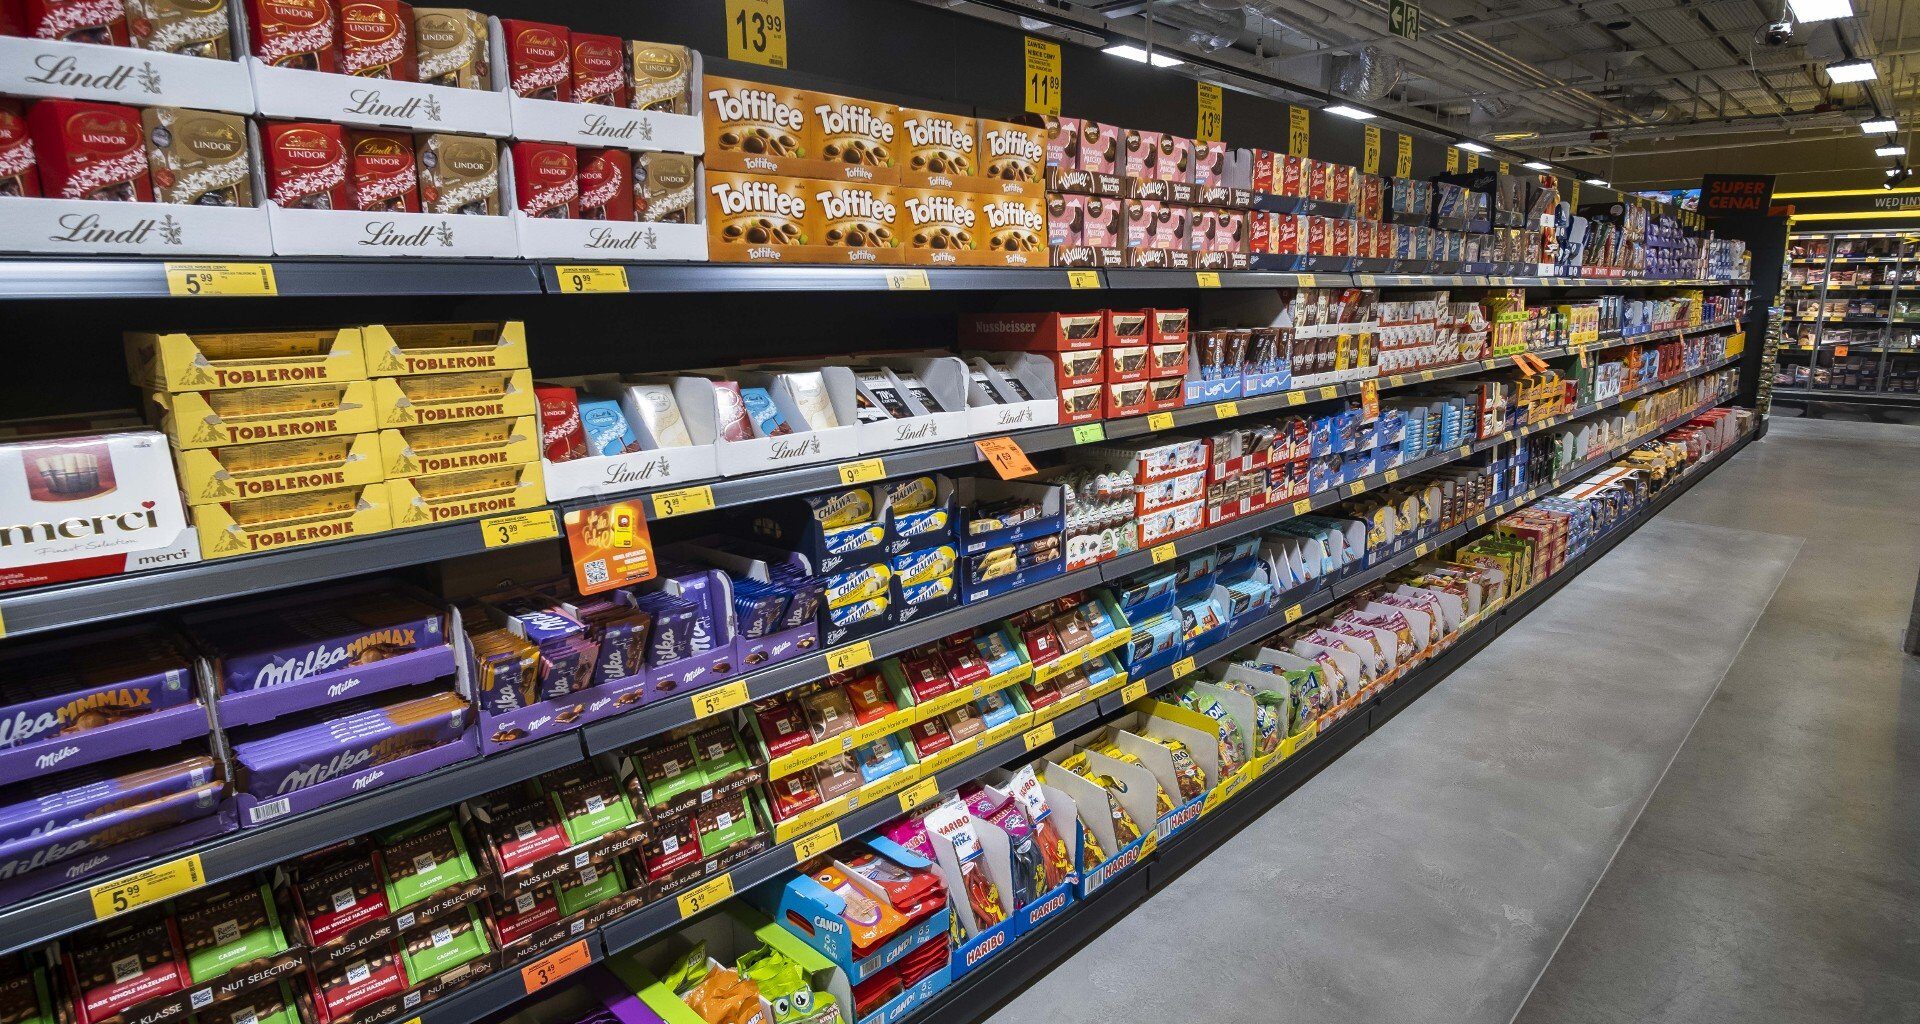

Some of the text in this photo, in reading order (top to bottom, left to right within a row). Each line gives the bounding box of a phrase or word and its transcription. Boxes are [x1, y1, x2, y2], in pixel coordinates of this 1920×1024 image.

[275, 7, 314, 19] LINDOR
[350, 24, 385, 34] LINDOR
[736, 9, 781, 52] 13 99
[526, 48, 555, 58] LINDOR
[25, 54, 134, 91] Lindt
[1031, 73, 1060, 106] 11 89
[343, 89, 422, 119] Lindt
[709, 89, 804, 131] Toffifee
[578, 114, 637, 139] Lindt
[815, 104, 894, 143] Toffifee
[1201, 110, 1214, 138] 13
[83, 134, 126, 146] LINDOR
[194, 141, 232, 152] LINDOR
[904, 118, 973, 153] Toffifee
[987, 130, 1043, 162] Toffifee
[288, 150, 326, 160] LINDOR
[366, 157, 400, 166] LINDOR
[540, 168, 567, 176] LINDOR
[1710, 181, 1766, 195] SUPER
[711, 181, 806, 219] Toffifee
[816, 189, 896, 223] Toffifee
[1708, 196, 1761, 210] CENA!
[905, 196, 975, 228] Toffifee
[984, 201, 1043, 229] Toffifee
[50, 213, 156, 244] Lindt
[358, 221, 436, 246] Lindt
[584, 227, 643, 250] Lindt
[186, 274, 200, 294] 5
[201, 274, 213, 282] 99
[573, 274, 591, 291] 9 99
[976, 321, 1037, 334] Nussbeisser
[406, 356, 495, 373] TOBLERONE
[215, 366, 327, 387] TOBLERONE
[415, 404, 503, 424] TOBLERONE
[226, 420, 337, 443] TOBLERONE
[767, 440, 811, 460] Lindt
[996, 454, 1008, 469] 1
[419, 452, 507, 473] TOBLERONE
[602, 461, 656, 485] Lindt
[235, 472, 344, 497] TOBLERONE
[847, 470, 854, 483] 9
[429, 497, 515, 521] TOBLERONE
[664, 500, 673, 515] 3
[819, 496, 851, 519] CHAŁWA
[0, 501, 158, 547] merci
[498, 526, 510, 543] 3
[34, 539, 137, 556] Finest Selection
[247, 522, 354, 550] TOBLERONE
[138, 549, 190, 564] merci
[909, 553, 938, 576] CHAŁWA
[8, 575, 48, 585] Chocolates
[838, 571, 870, 596] CHAŁWA
[347, 629, 416, 657] MMMAX
[838, 657, 844, 668] 4
[684, 667, 706, 683] Milka
[327, 678, 361, 697] Milka
[56, 688, 151, 724] MMMAX
[590, 696, 612, 712] Milka
[706, 699, 714, 714] 5
[0, 711, 61, 748] lka
[528, 715, 551, 731] Milka
[36, 746, 80, 769] Milka
[352, 770, 384, 790] Milka
[717, 773, 761, 795] NUT SELECTION
[656, 799, 697, 820] NUSS KLASSE
[909, 795, 914, 807] 5
[791, 810, 834, 833] Lieblingssorten
[1171, 801, 1203, 831] HARIBO
[594, 832, 648, 858] NUT SELECTION
[66, 856, 110, 878] Milka
[1105, 845, 1140, 879] HARIBO
[420, 875, 443, 888] CASHEW
[519, 863, 570, 889] NUSS KLASSE
[661, 869, 701, 893] NUSS KLASSE
[112, 885, 140, 912] 5 99
[182, 892, 258, 922] NUT SELECTION
[336, 898, 354, 909] SPORT
[422, 885, 486, 918] NUT SELECTION
[590, 896, 643, 924] NUT SELECTION
[1029, 893, 1065, 924] HARIBO
[314, 902, 383, 935] DARK WHOLE HAZELNUTS
[814, 916, 843, 935] CANDI
[218, 930, 239, 941] SPORT
[330, 926, 391, 960] NUSS KLASSE
[517, 930, 566, 957] NUSS KLASSE
[218, 946, 247, 960] CASHEW
[437, 948, 459, 961] CASHEW
[966, 931, 1005, 966] HARIBO
[221, 957, 303, 994] NUT SELECTION
[538, 969, 548, 985] 3
[88, 972, 177, 1010] DARK WHOLE HAZELNUTS
[329, 974, 397, 1008] DARK WHOLE HAZELNUTS
[140, 1003, 183, 1024] KLASSE
[364, 1005, 397, 1024] KLASSE
